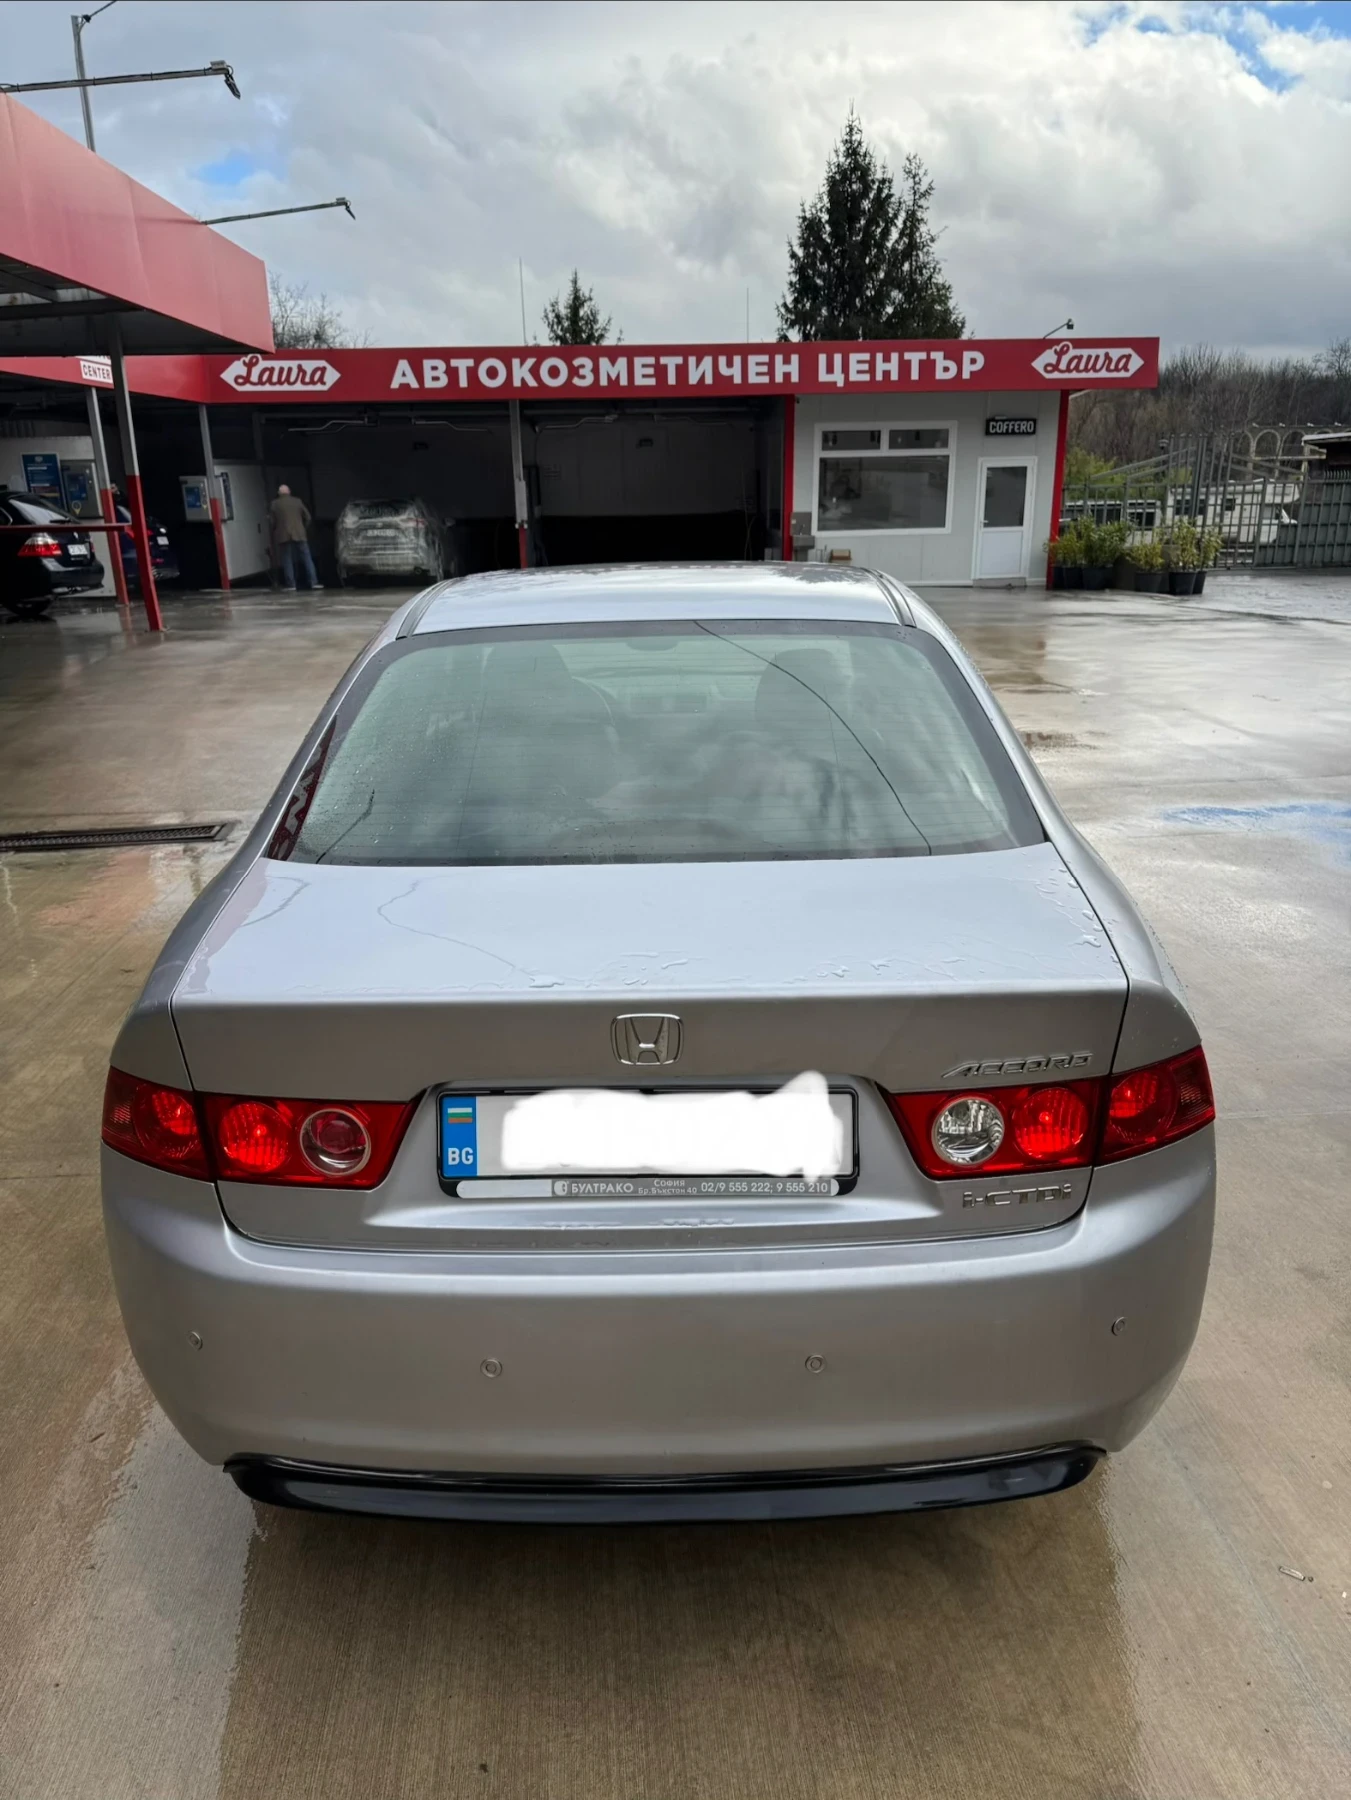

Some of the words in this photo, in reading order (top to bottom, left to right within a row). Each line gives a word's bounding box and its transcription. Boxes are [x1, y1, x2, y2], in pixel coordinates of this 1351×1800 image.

[1042, 343, 1131, 376] Laura
[82, 364, 111, 379] CENTER
[233, 355, 327, 388] Laura
[390, 355, 800, 388] АВТОКОЗМЕТИЧЕН
[818, 350, 984, 387] ЦЕНТЪР
[989, 420, 1035, 434] COFFERO
[941, 1053, 1092, 1078] ACCORD
[447, 1147, 473, 1165] BG
[571, 1182, 634, 1194] БУЛТРАКО
[687, 1187, 698, 1195] 40
[701, 1182, 726, 1194] 02/9
[728, 1182, 748, 1193] 555
[751, 1182, 773, 1194] 222;
[776, 1182, 783, 1193] 9
[785, 1182, 805, 1193] 555
[807, 1181, 828, 1194] 210
